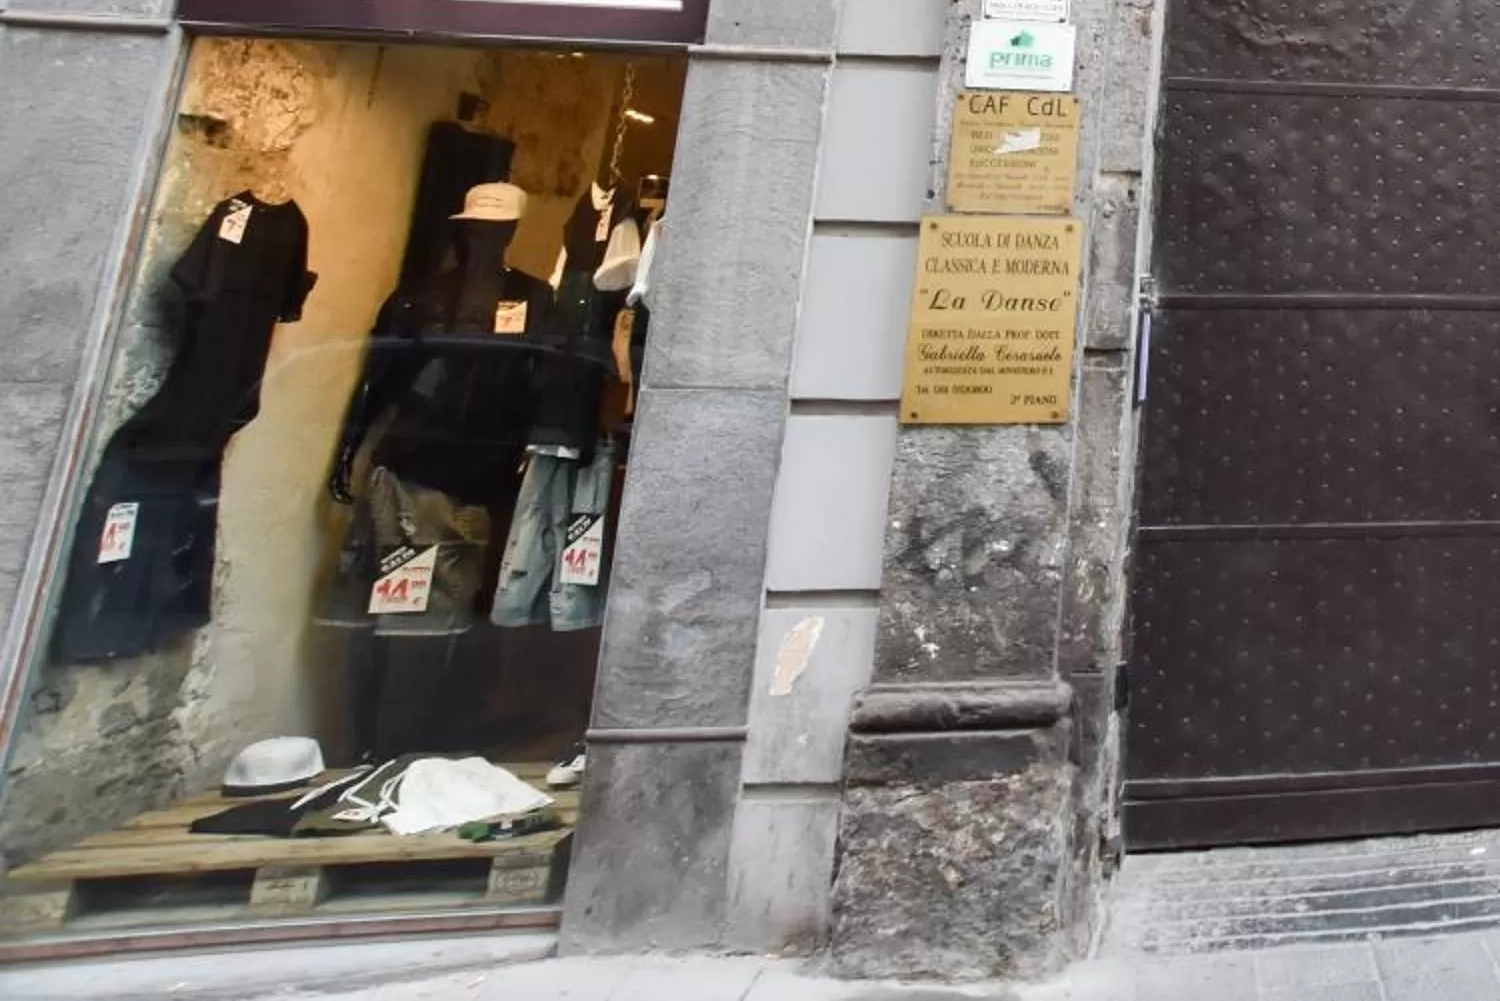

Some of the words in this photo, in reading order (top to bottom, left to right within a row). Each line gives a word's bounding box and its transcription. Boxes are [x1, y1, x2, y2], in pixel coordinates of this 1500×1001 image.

[989, 52, 1054, 69] prima
[969, 94, 1010, 115] CAF
[1027, 96, 1068, 117] CdL
[941, 231, 992, 249] SCUOLA
[996, 232, 1011, 249] DI
[1015, 233, 1060, 250] DANZA
[925, 257, 987, 275] CLASSICA
[992, 259, 1002, 274] E
[1005, 258, 1069, 276] MODERNA
[1023, 394, 1057, 406] PIANO
